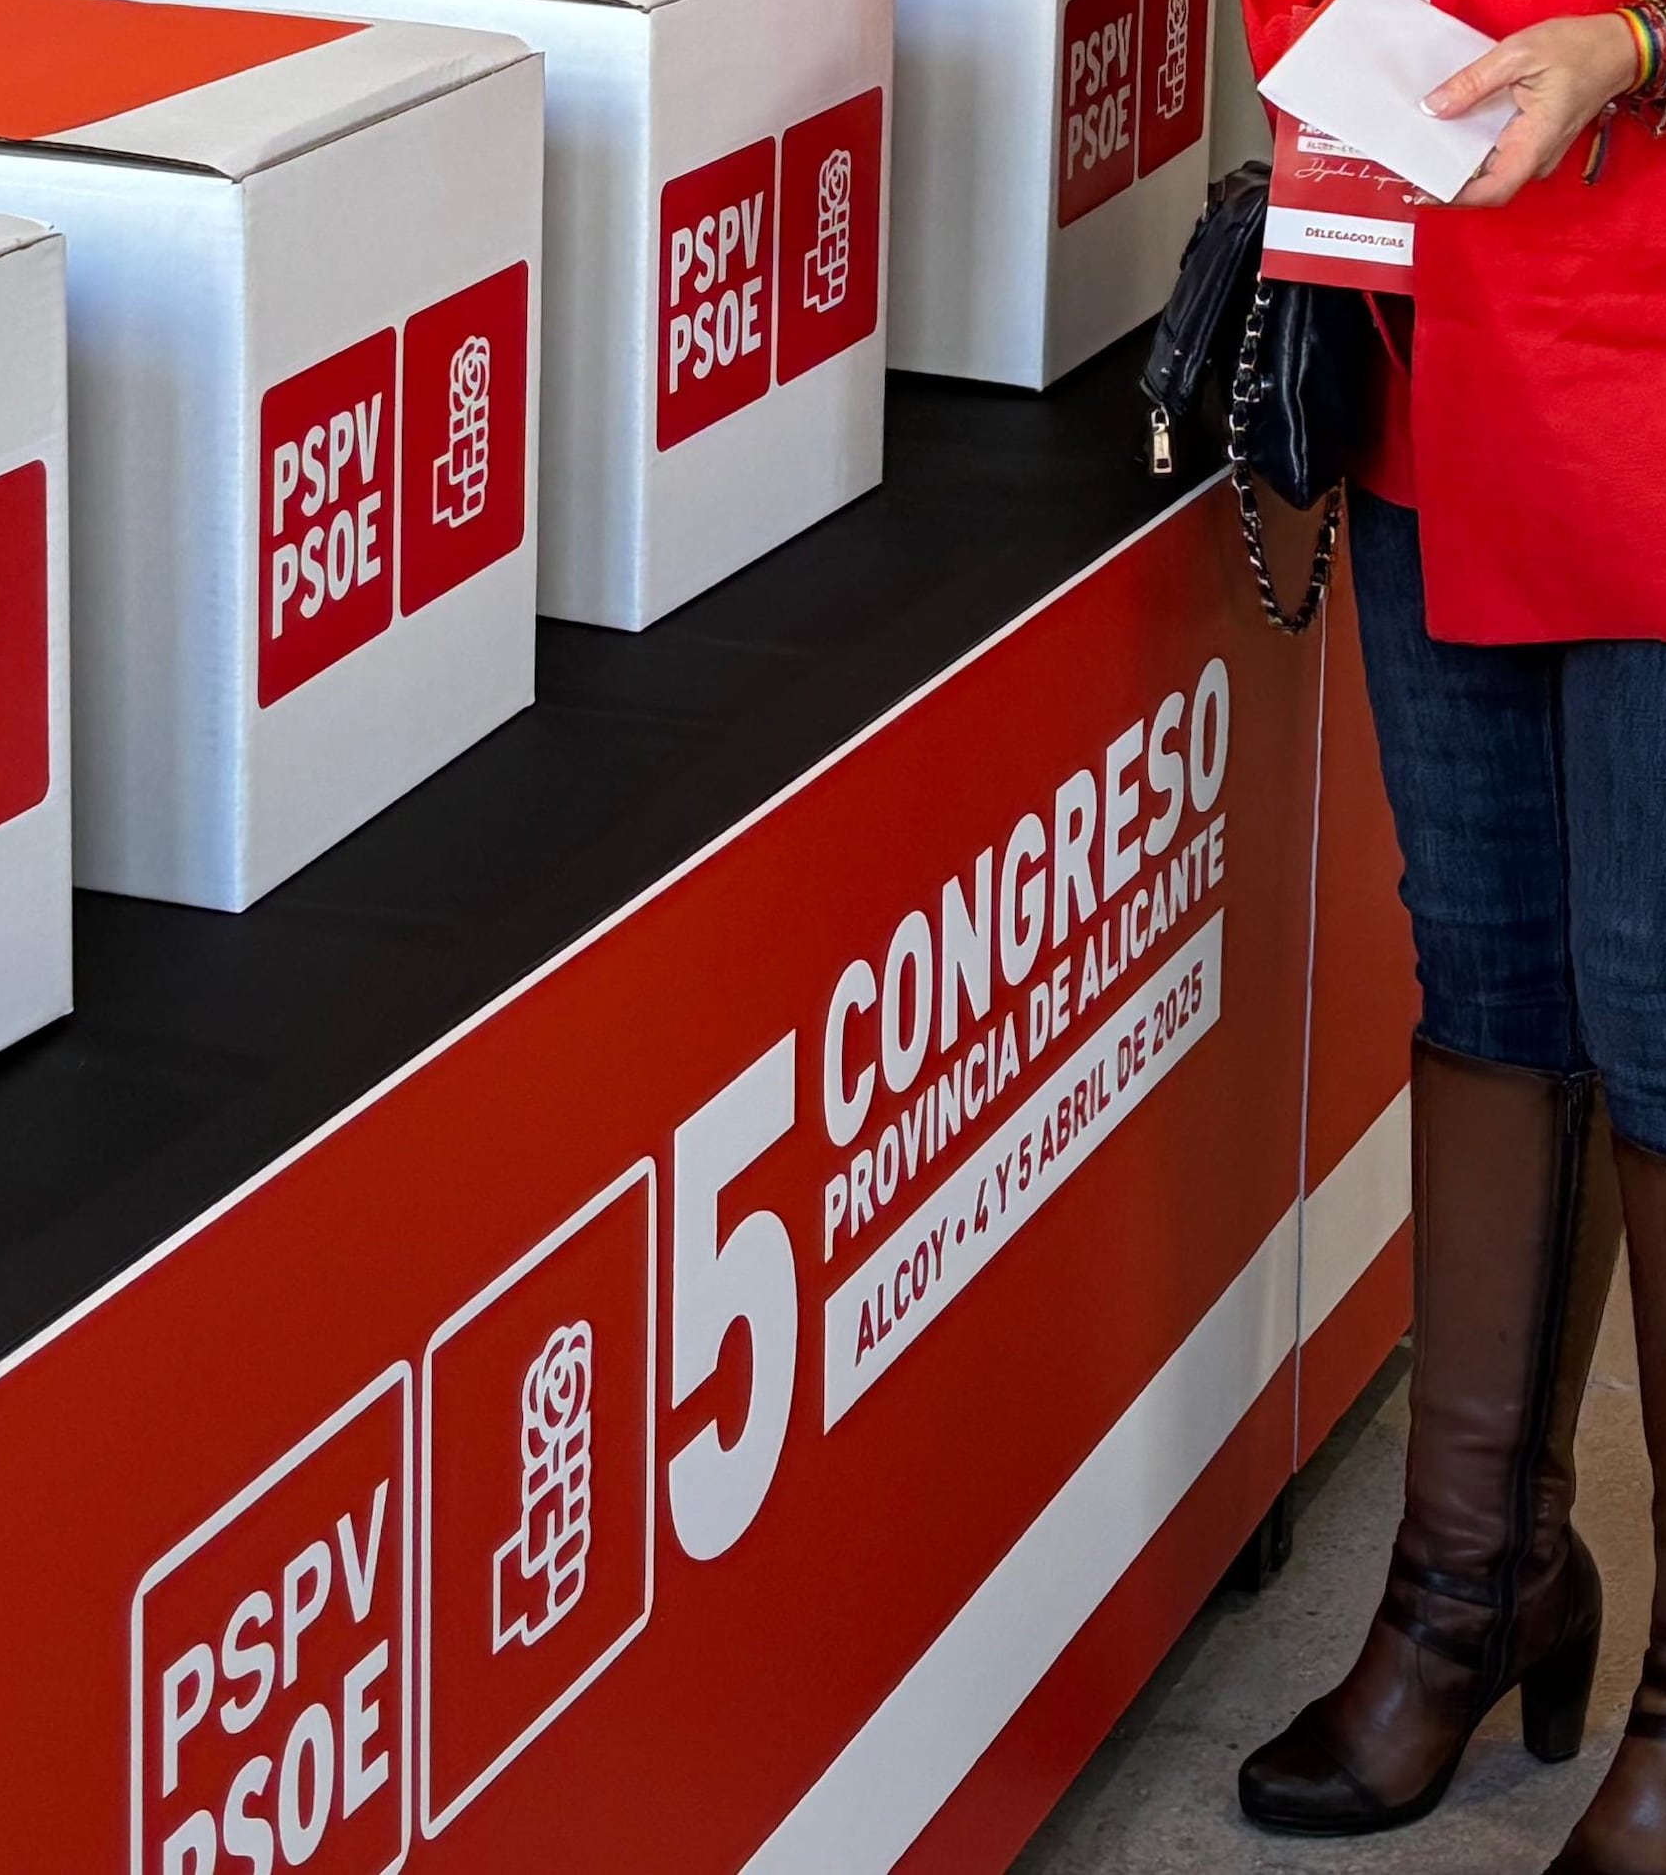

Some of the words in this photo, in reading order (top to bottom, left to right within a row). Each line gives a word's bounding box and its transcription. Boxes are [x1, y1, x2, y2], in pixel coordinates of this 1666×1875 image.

[1067, 84, 1131, 180] PSOE
[1069, 13, 1133, 107] PSPV
[670, 191, 764, 307] PSPV
[668, 275, 763, 395] PSOE
[272, 391, 383, 538] PSPV
[271, 490, 383, 640] PSOE
[823, 657, 1230, 1147] CONGRESO
[824, 1011, 1021, 1264] PROVINCIA
[1029, 955, 1072, 1062] DE
[1077, 813, 1226, 1016] ALICANTE
[855, 1224, 947, 1368] ALCOY
[973, 1177, 989, 1235] 4
[997, 1152, 1013, 1215] Y
[1018, 1132, 1032, 1193] 5
[1038, 1057, 1111, 1177] ABRIL
[1117, 1014, 1147, 1091] DE
[1152, 959, 1205, 1054] 2025
[668, 1028, 799, 1561] 5
[162, 1477, 390, 1799] PSPV
